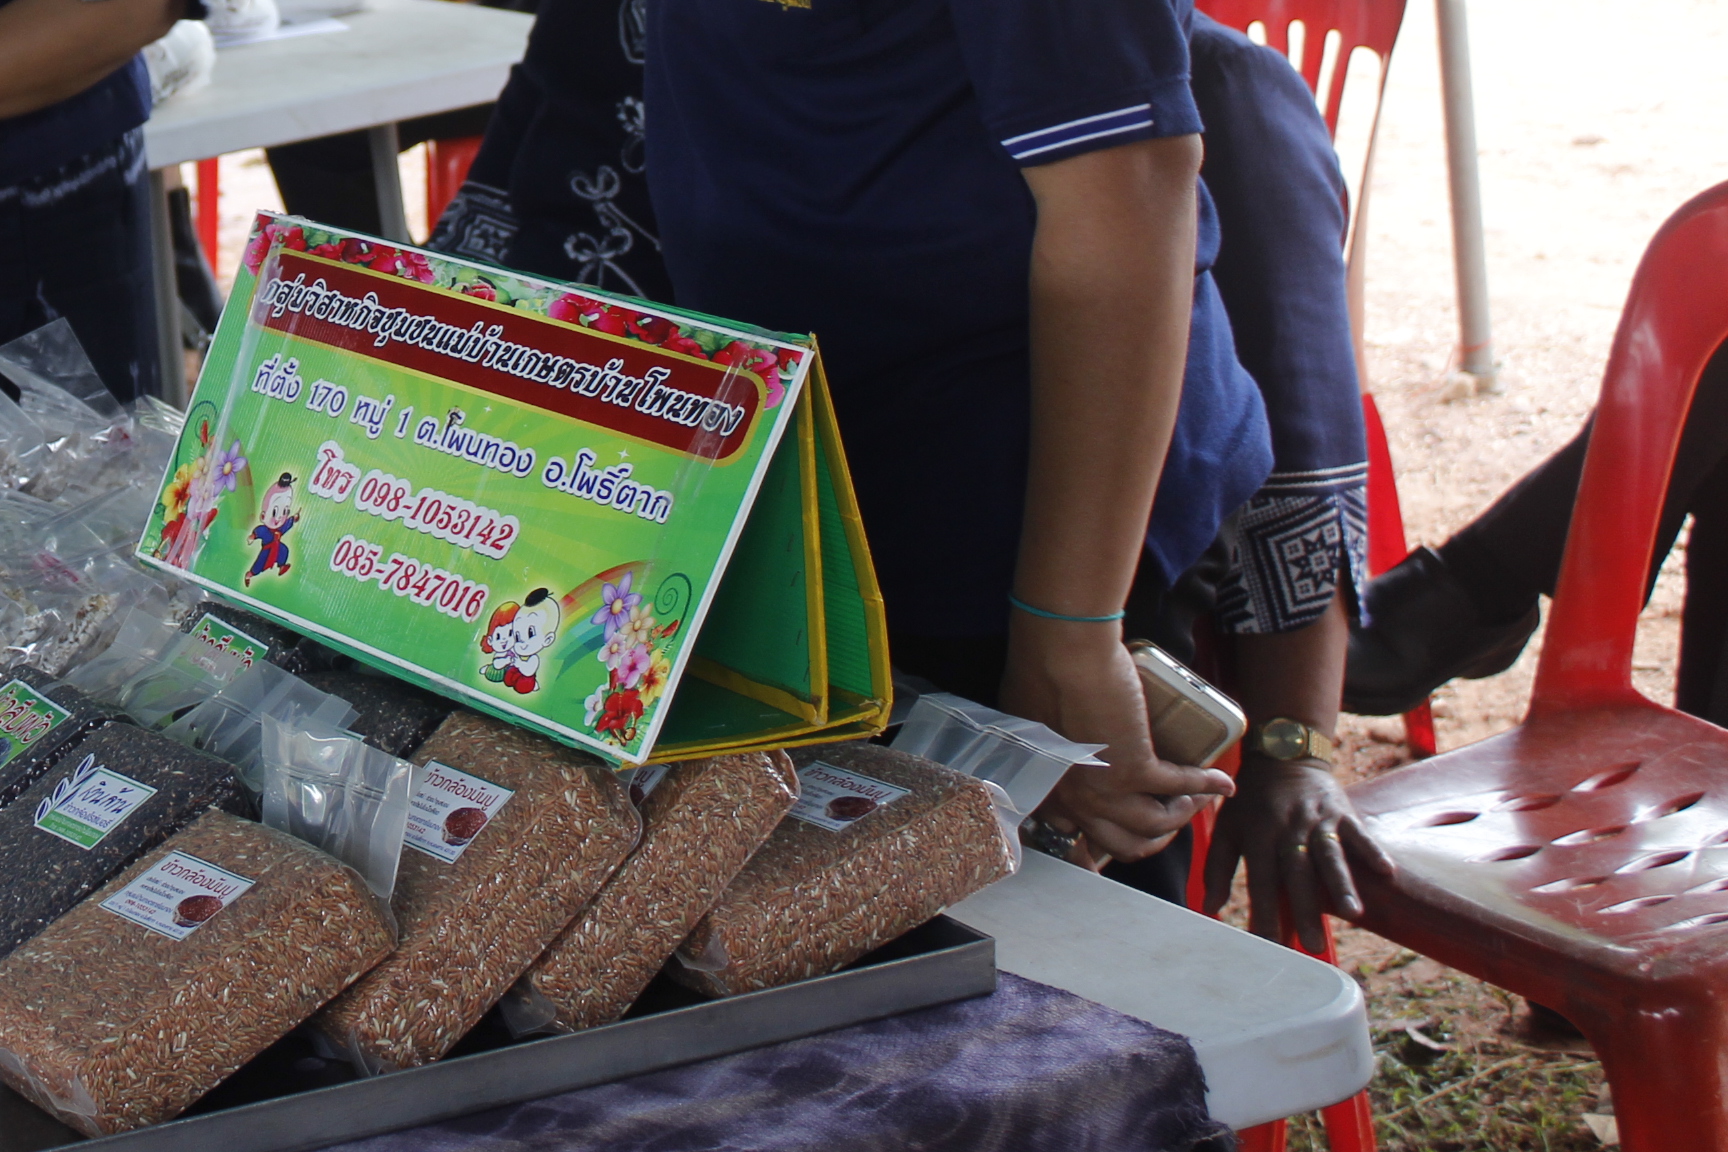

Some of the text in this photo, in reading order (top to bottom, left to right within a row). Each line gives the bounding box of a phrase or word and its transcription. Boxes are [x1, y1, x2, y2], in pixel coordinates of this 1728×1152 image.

[261, 273, 744, 436] กลุ่มวิสาหกิจชุมชนแม่บ้านเกษตรบ้านโพนทอง
[253, 355, 673, 523] ที่ตั้ง 170 หมู่ 1 ต.โพนทอง อ.โพธิ์ตาก
[311, 445, 516, 555] โทร 098-1053142
[332, 538, 487, 620] 085-7847016
[804, 768, 894, 801] ข้าวกล้องมันปู
[160, 859, 239, 899] ข้าวกล้องมันปู
